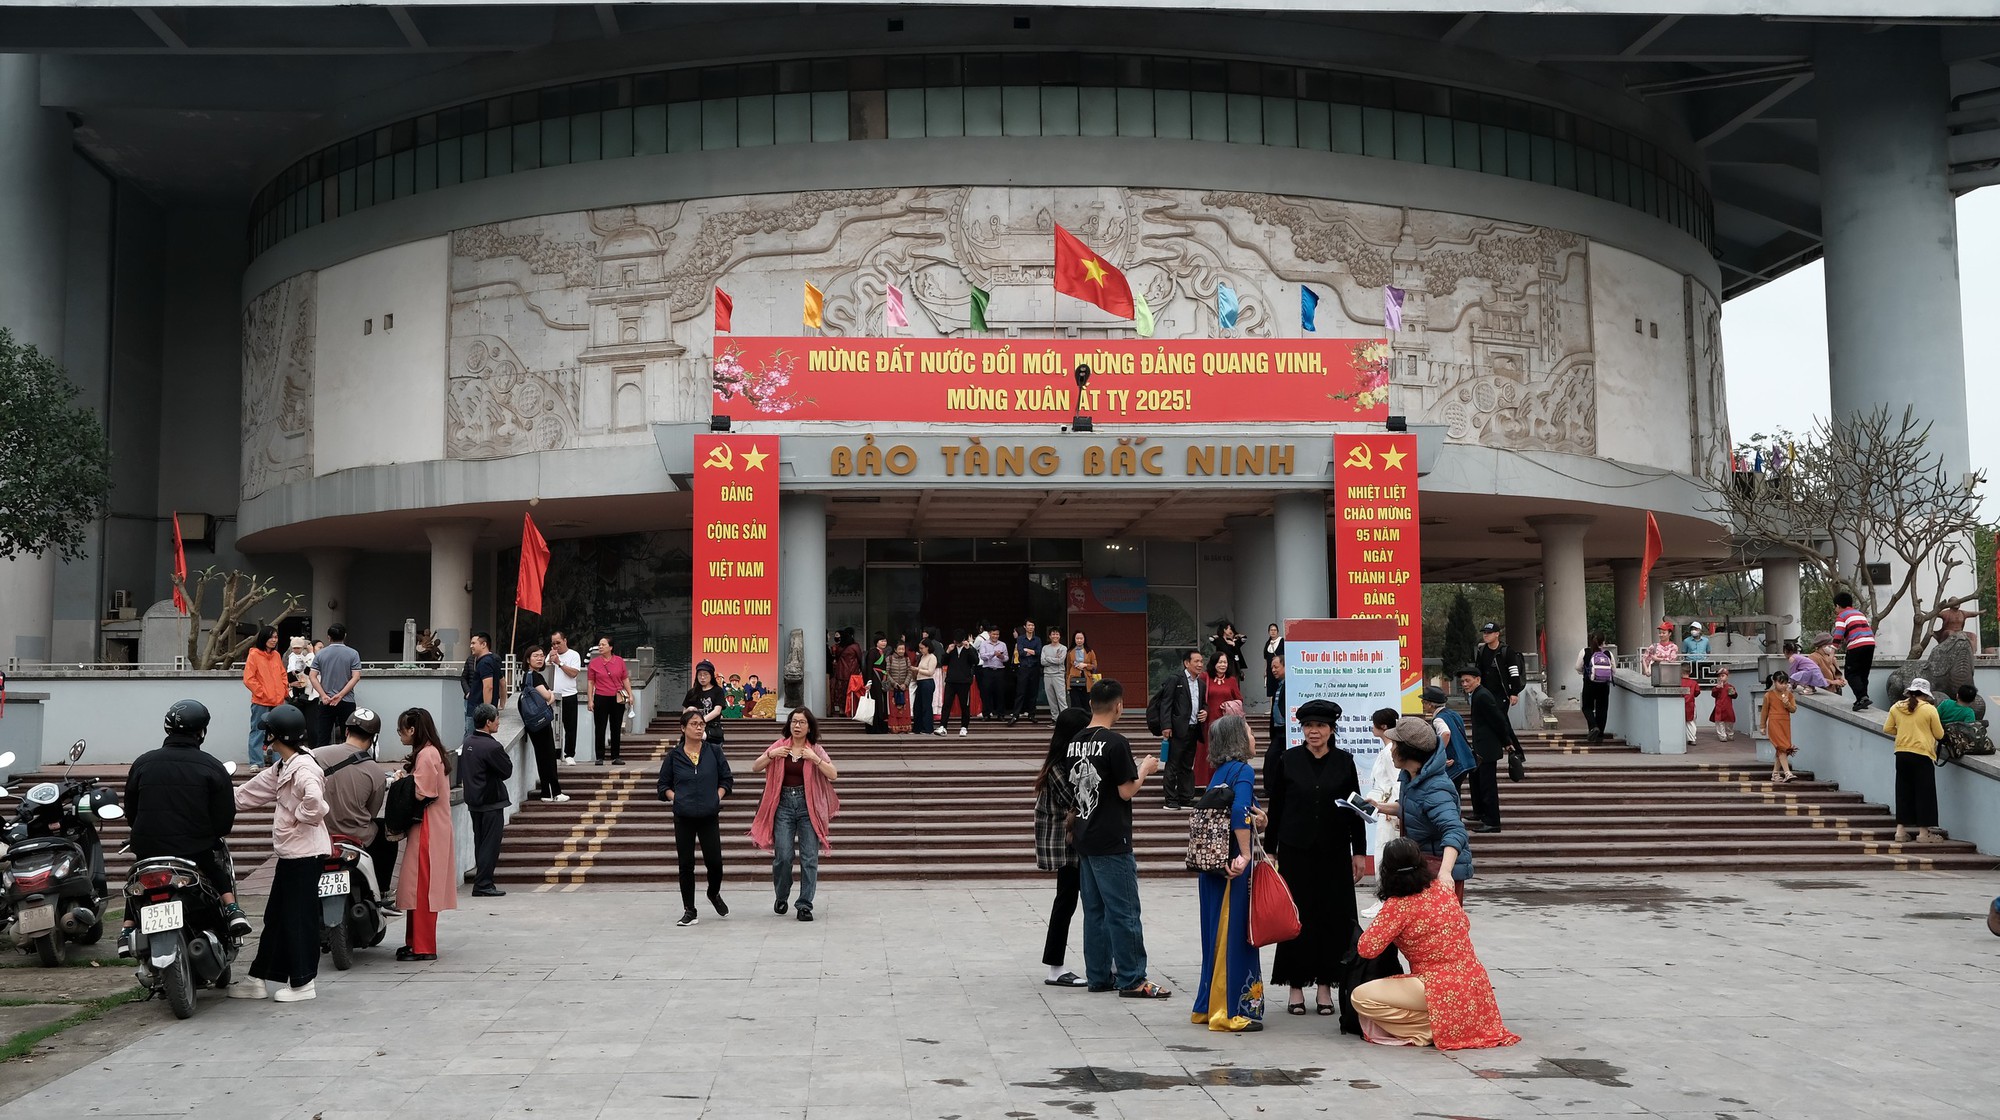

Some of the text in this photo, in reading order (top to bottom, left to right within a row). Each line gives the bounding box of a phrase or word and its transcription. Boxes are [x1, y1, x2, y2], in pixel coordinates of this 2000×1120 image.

[808, 346, 870, 372] MỪNG
[876, 344, 915, 373] ĐẤT
[920, 347, 976, 374] NƯỚC
[982, 344, 1016, 374] ĐỔI
[1022, 348, 1068, 377] MỚI,
[1140, 346, 1196, 375] ĐẢNG
[1202, 352, 1269, 376] QUANG
[1274, 352, 1328, 376] VINH,
[947, 384, 1008, 411] MỪNG
[1014, 385, 1070, 411] XUÂN
[1107, 389, 1130, 416] TỴ
[1135, 389, 1191, 411] 2025!
[831, 433, 1295, 476] BẢO TÀNG BẮC NINH
[721, 481, 753, 502] ĐẢNG
[1348, 483, 1407, 502] NHIỆT LIỆT
[1344, 504, 1412, 520] CHÀO MỪNG
[707, 518, 767, 543] CỘNG SẢN
[1356, 526, 1400, 541] 95 NĂM
[1363, 547, 1394, 563] NGÀY
[709, 558, 764, 581] VIỆT NAM
[1348, 568, 1410, 587] THÀNH LẬP
[1363, 588, 1395, 605] ĐẢNG
[701, 599, 771, 617] QUANG VINH
[703, 634, 769, 653] MUÔN NĂM
[1301, 650, 1318, 662] Tour
[1320, 650, 1331, 662] du
[1332, 650, 1348, 664] lịch
[1371, 649, 1384, 664] phí
[320, 873, 344, 885] 22-B2
[147, 904, 175, 919] 35-N1
[144, 915, 180, 932] 424.94
